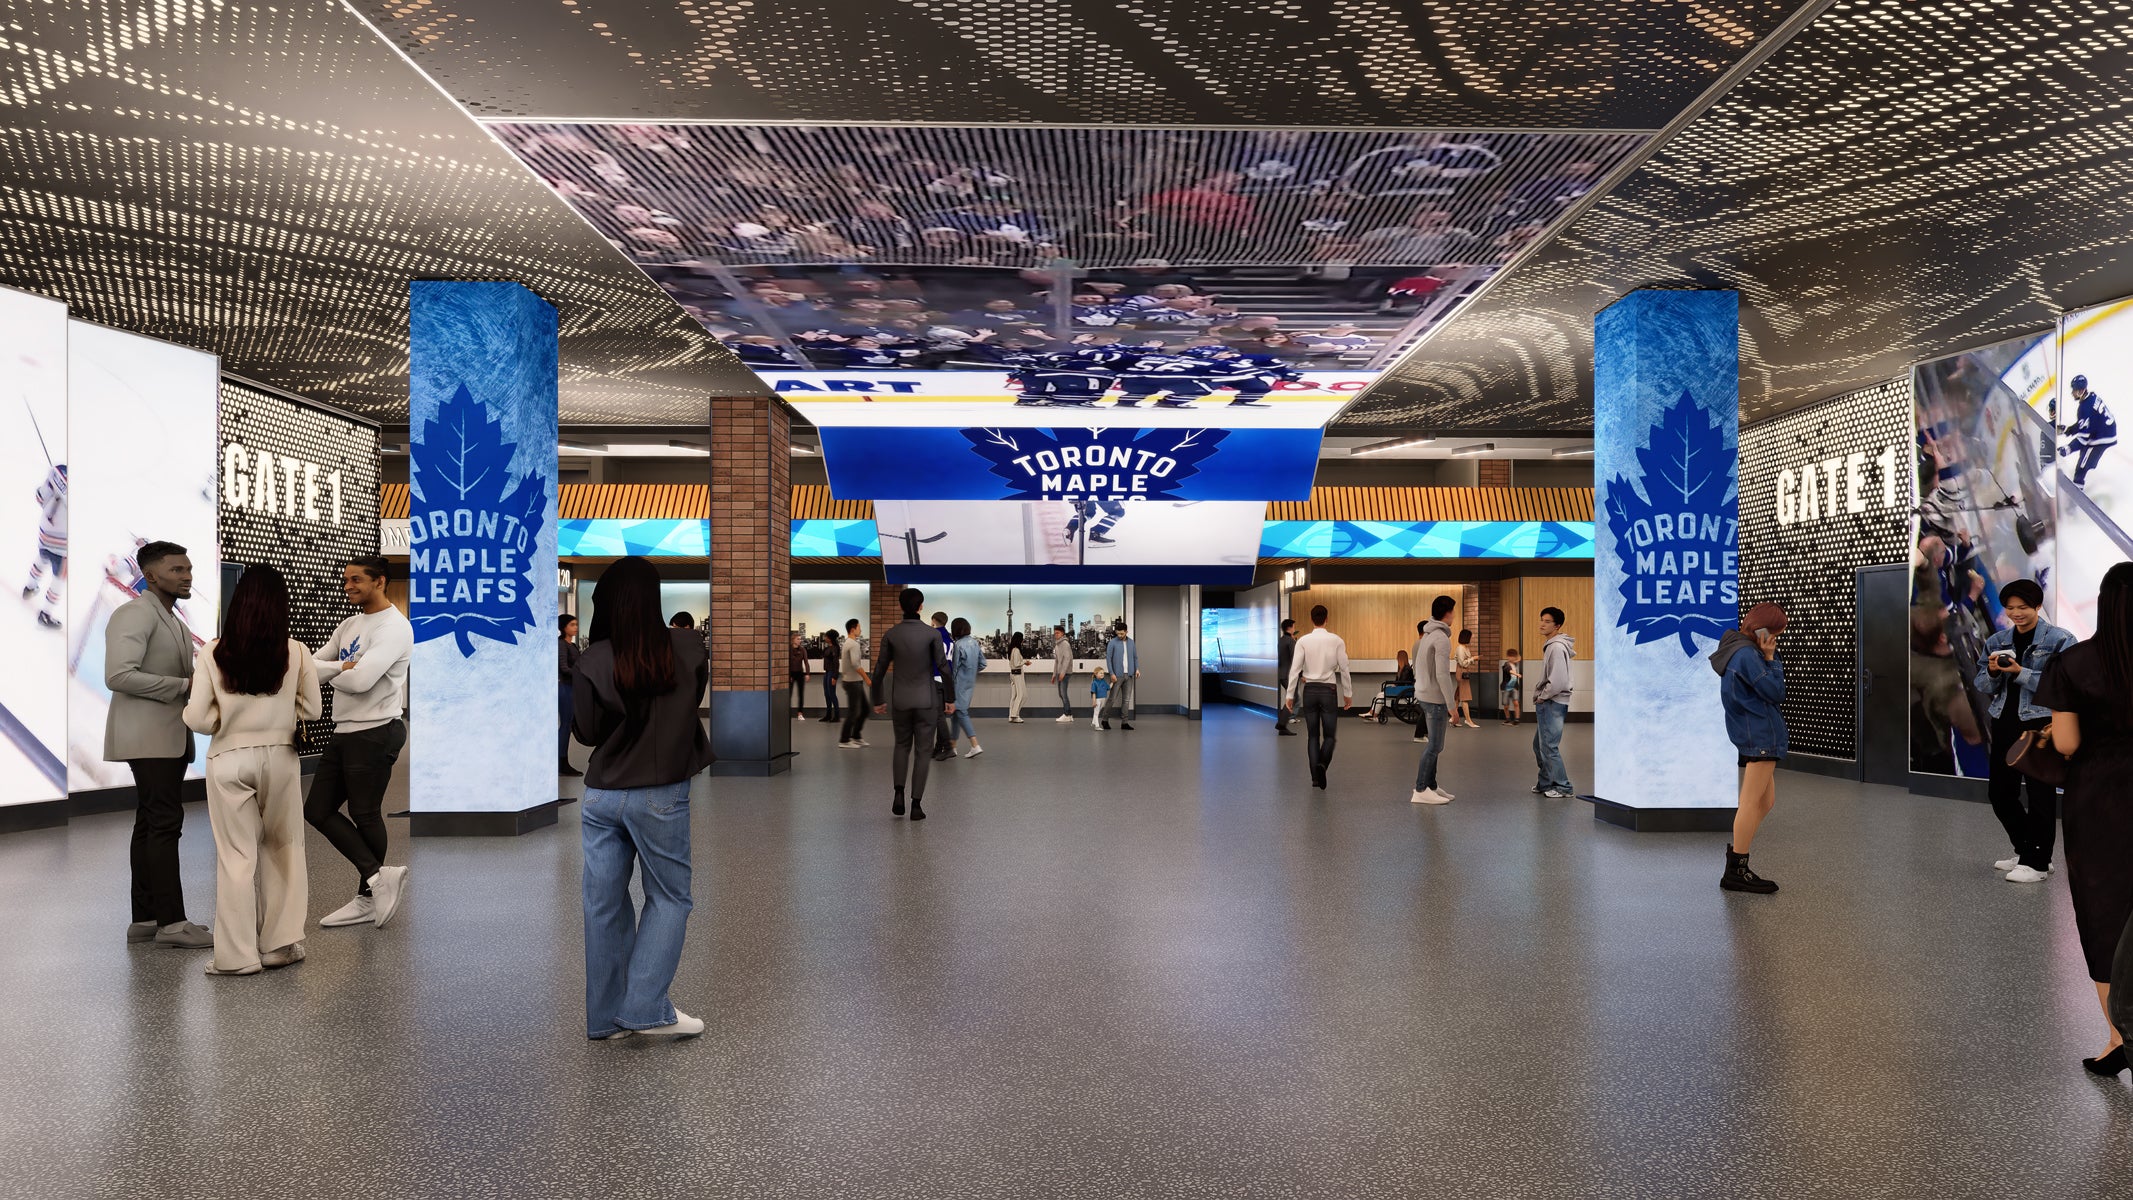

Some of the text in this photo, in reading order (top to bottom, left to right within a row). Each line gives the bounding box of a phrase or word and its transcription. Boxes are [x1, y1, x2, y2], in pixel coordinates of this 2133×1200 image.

[774, 379, 922, 393] ART
[1012, 445, 1177, 478] TORONTO
[225, 442, 341, 525] GATE 1
[1042, 474, 1148, 492] MAPLE
[1777, 444, 1896, 526] GATE 1
[410, 548, 517, 573] MAPLE
[1636, 551, 1738, 575] MAPLE
[410, 578, 517, 603] LEAFS
[1636, 580, 1738, 605] LEAFS
